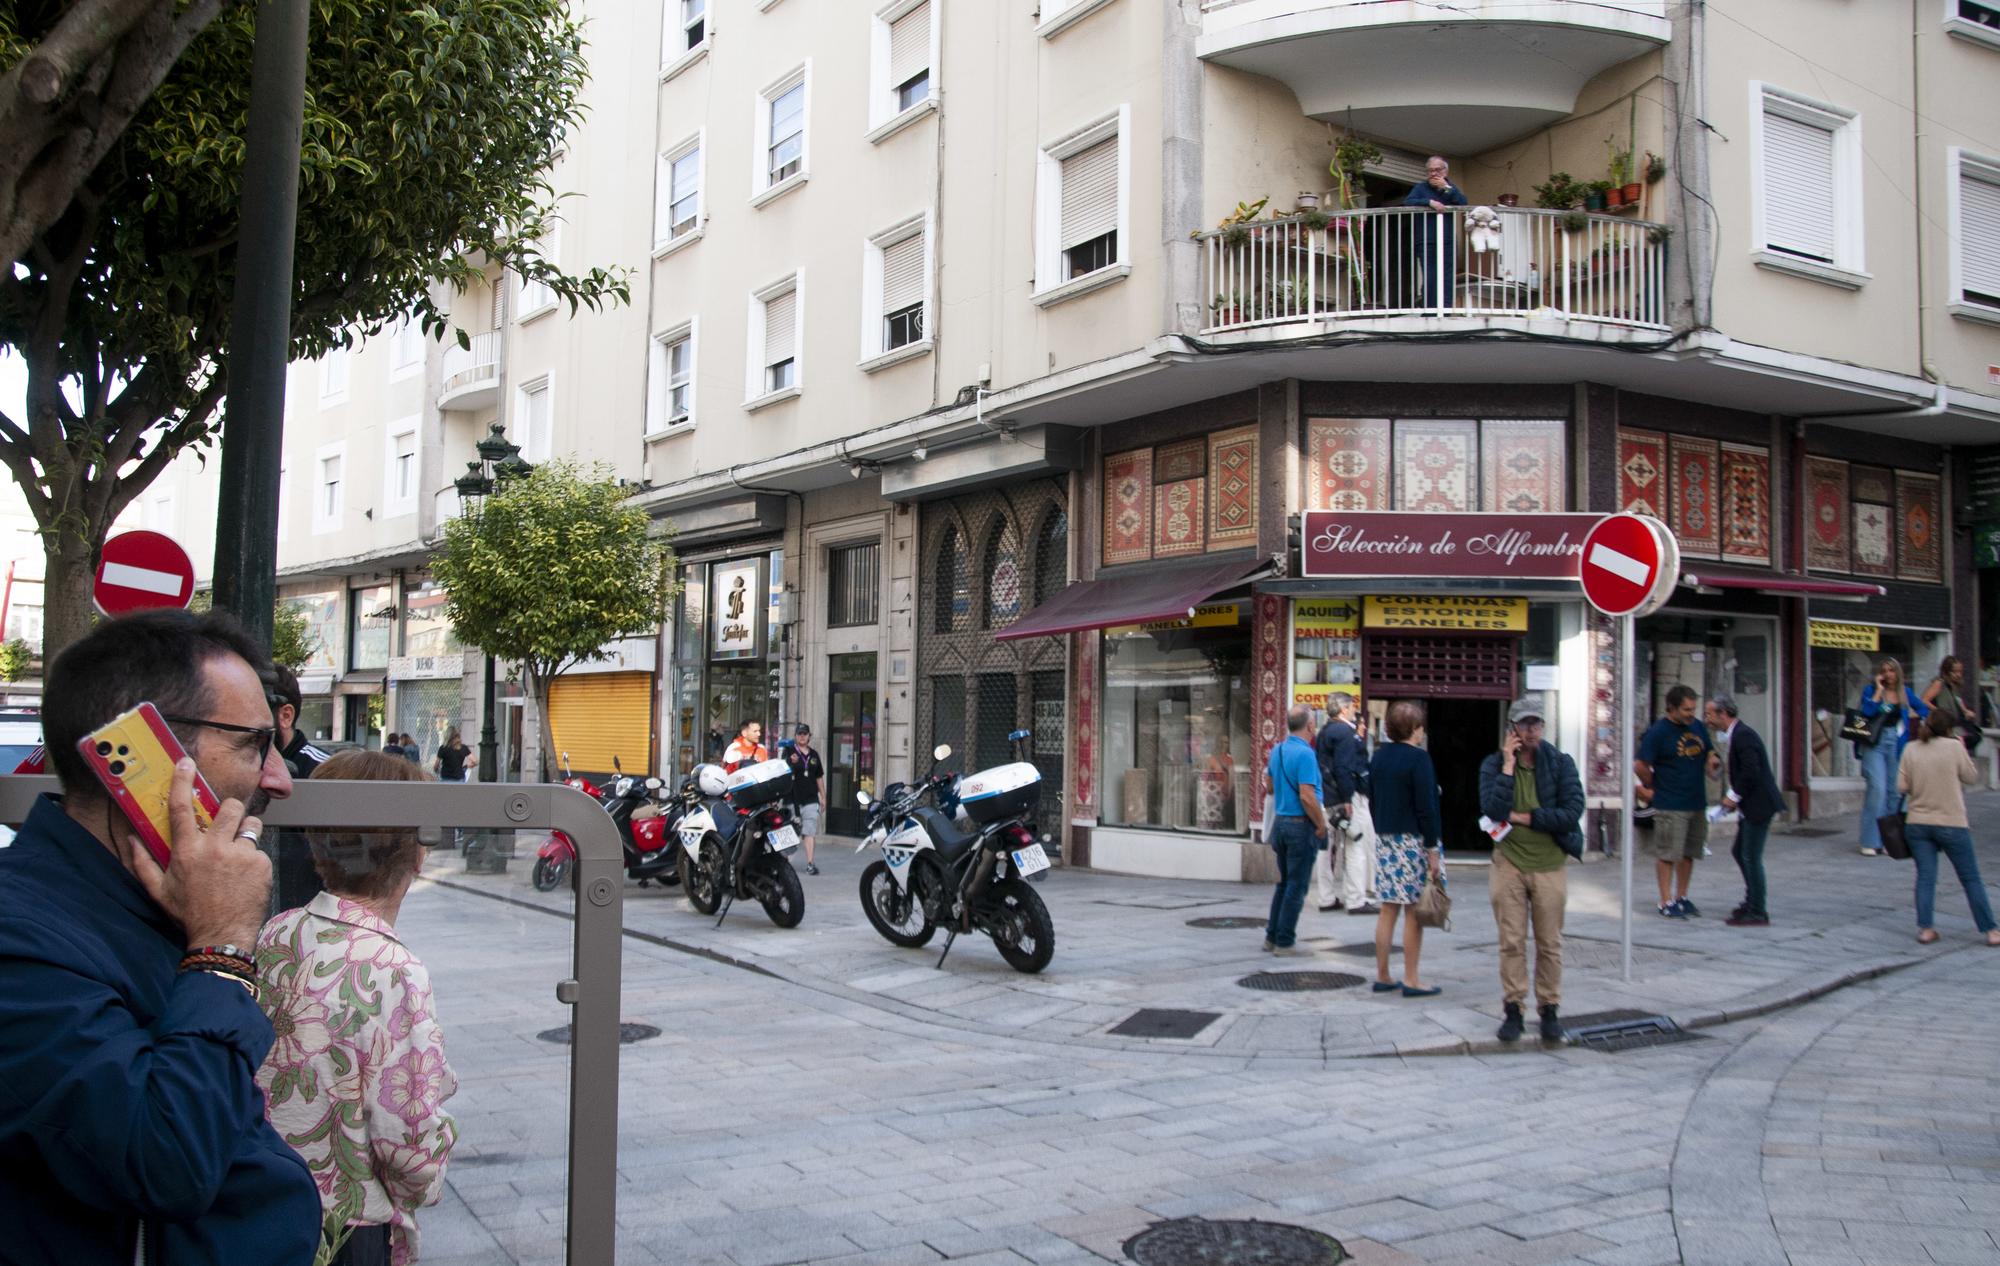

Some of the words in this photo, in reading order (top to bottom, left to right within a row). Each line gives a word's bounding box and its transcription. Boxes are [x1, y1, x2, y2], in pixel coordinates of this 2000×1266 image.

[1311, 523, 1424, 554] Selección
[1429, 530, 1456, 554] de
[1375, 596, 1518, 607] CORTINAS
[1383, 607, 1509, 618] ESTORES
[1384, 618, 1508, 628] PANELES
[1296, 628, 1360, 639] PANELES
[1813, 631, 1872, 641] ESTORES
[1813, 639, 1872, 649] PANELES
